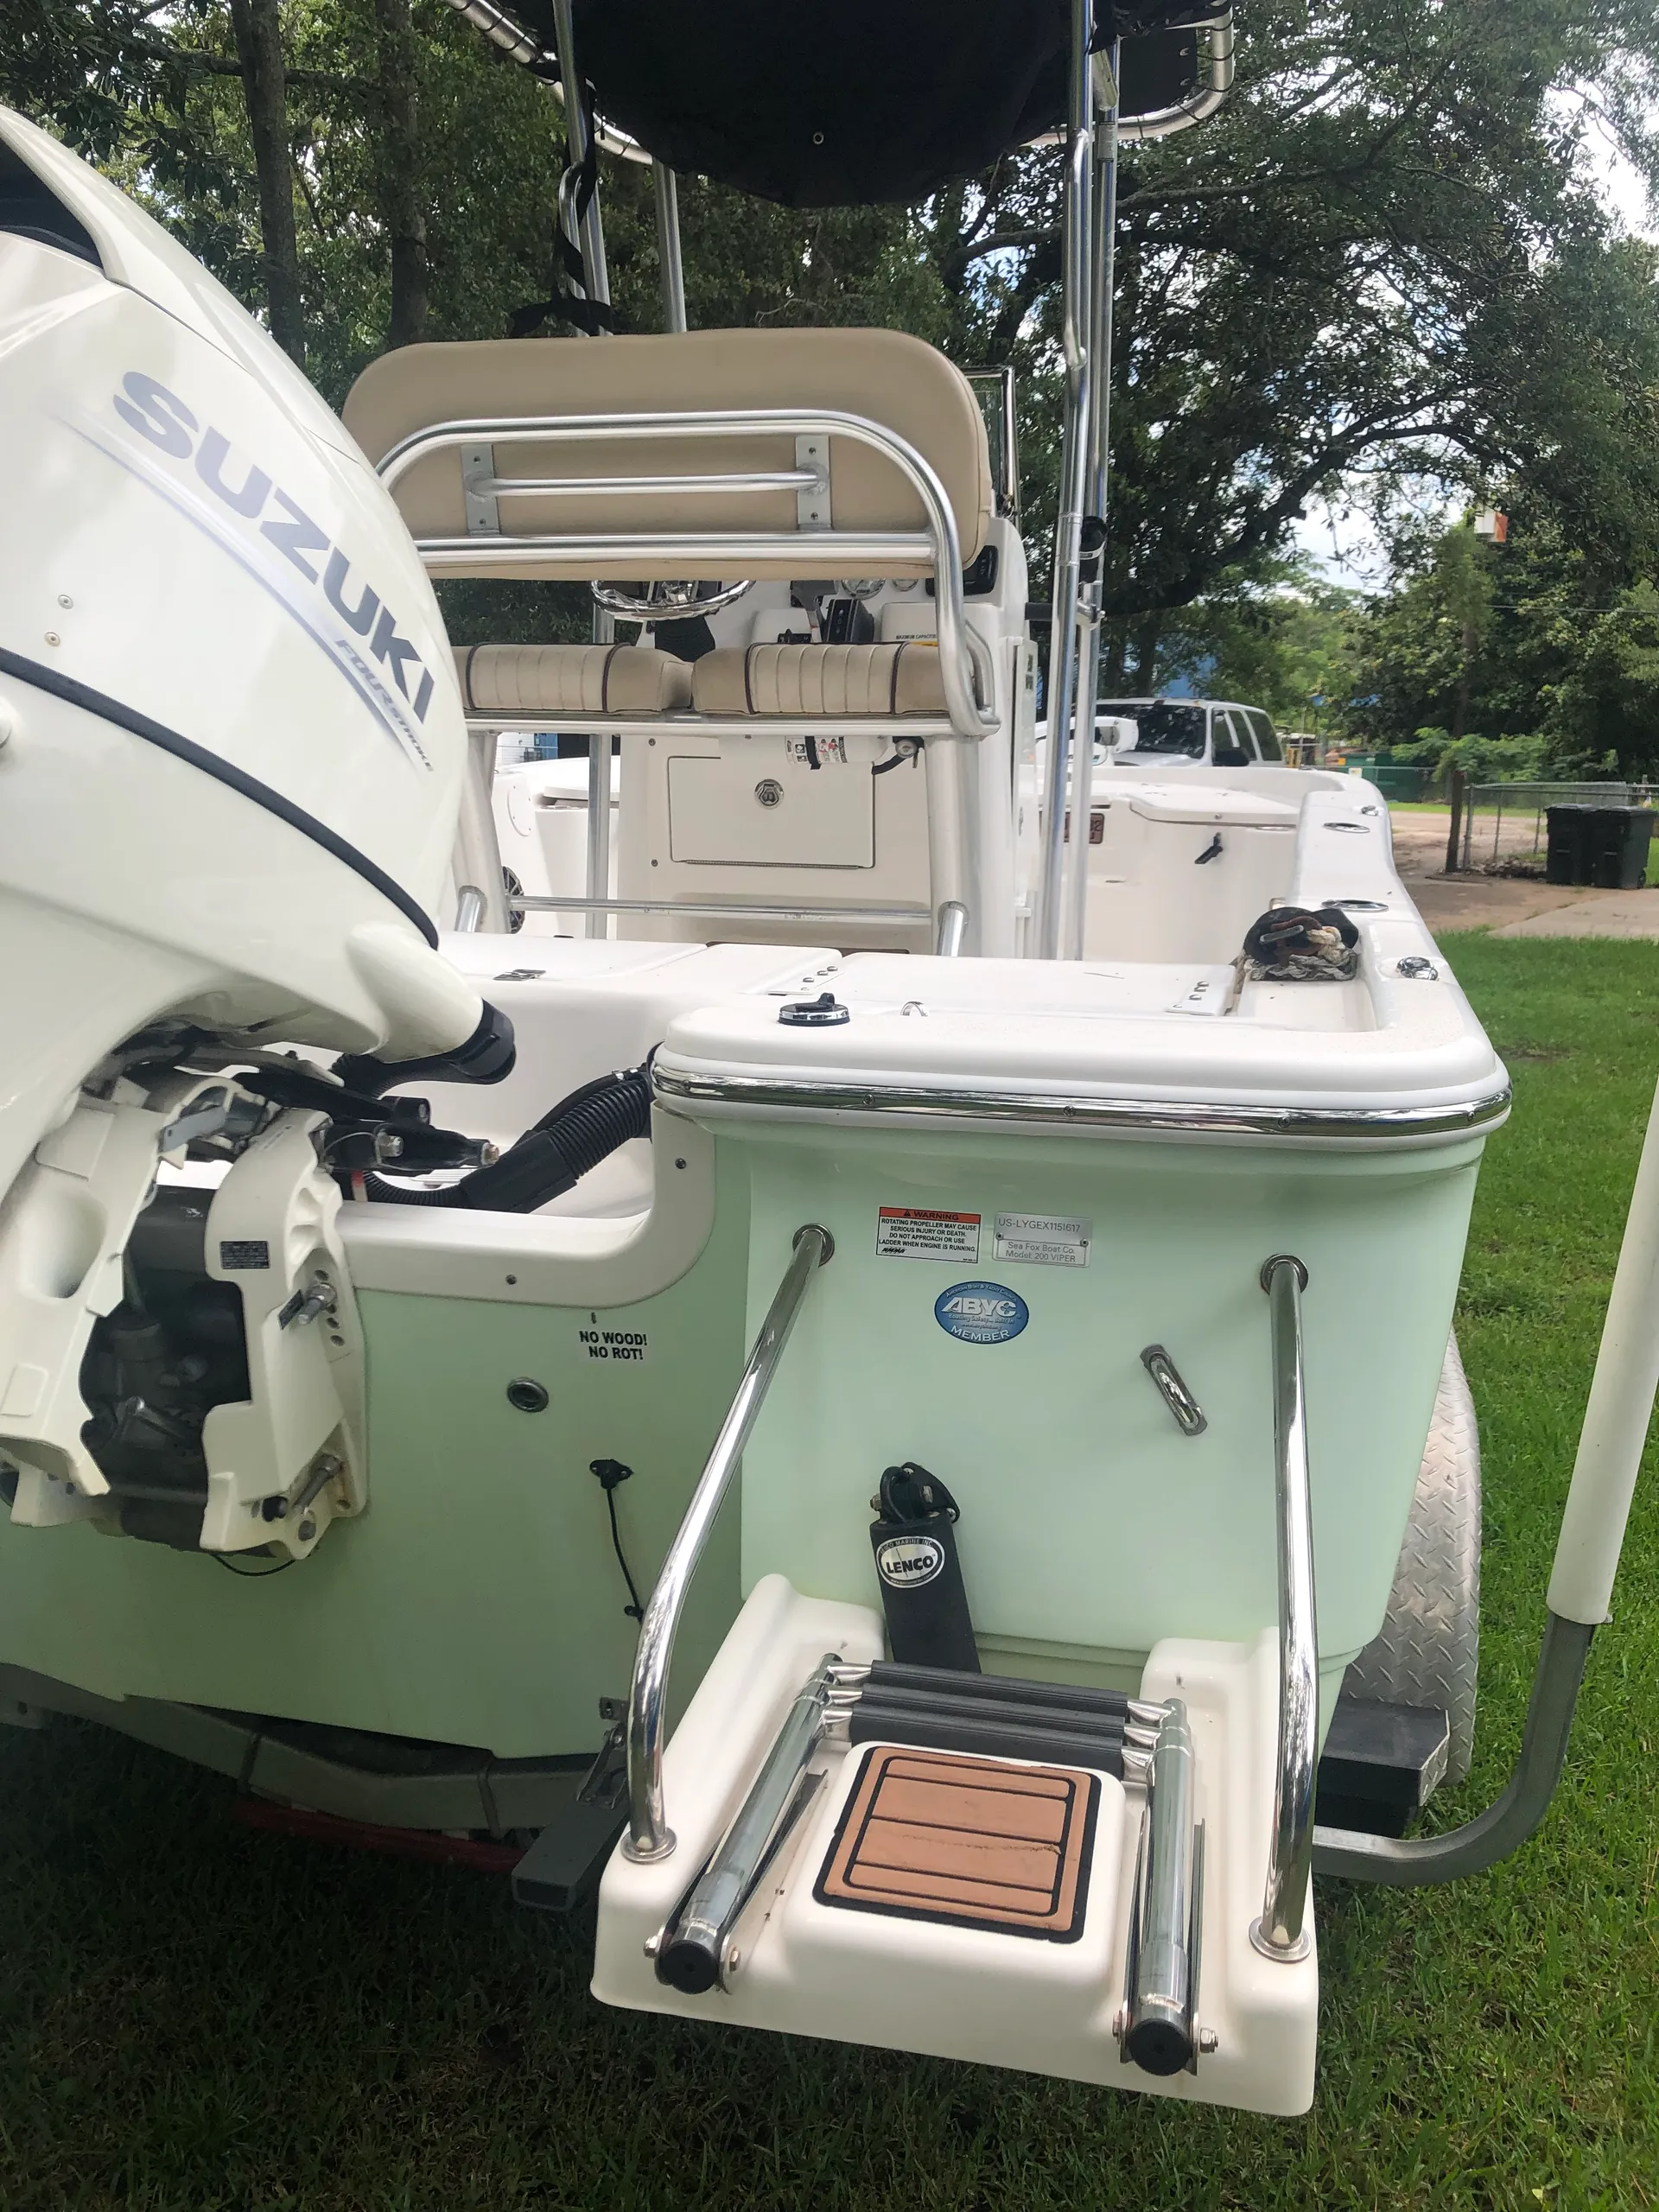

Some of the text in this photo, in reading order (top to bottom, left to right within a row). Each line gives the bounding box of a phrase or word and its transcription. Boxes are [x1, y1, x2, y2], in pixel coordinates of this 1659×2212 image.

[112, 372, 435, 725] SUZUKI
[914, 1211, 959, 1220] WARNING
[910, 1220, 944, 1228] PROPELLER
[1006, 1250, 1032, 1259] Model:
[1008, 1242, 1023, 1250] Sea
[1025, 1243, 1040, 1251] Fox
[1042, 1244, 1061, 1253] Boat
[941, 1297, 1017, 1317] ABYC
[579, 1331, 648, 1346] NO WOOD!
[950, 1325, 1010, 1341] MEMBER
[588, 1346, 643, 1360] NO ROT!
[886, 1555, 934, 1573] LENCO
